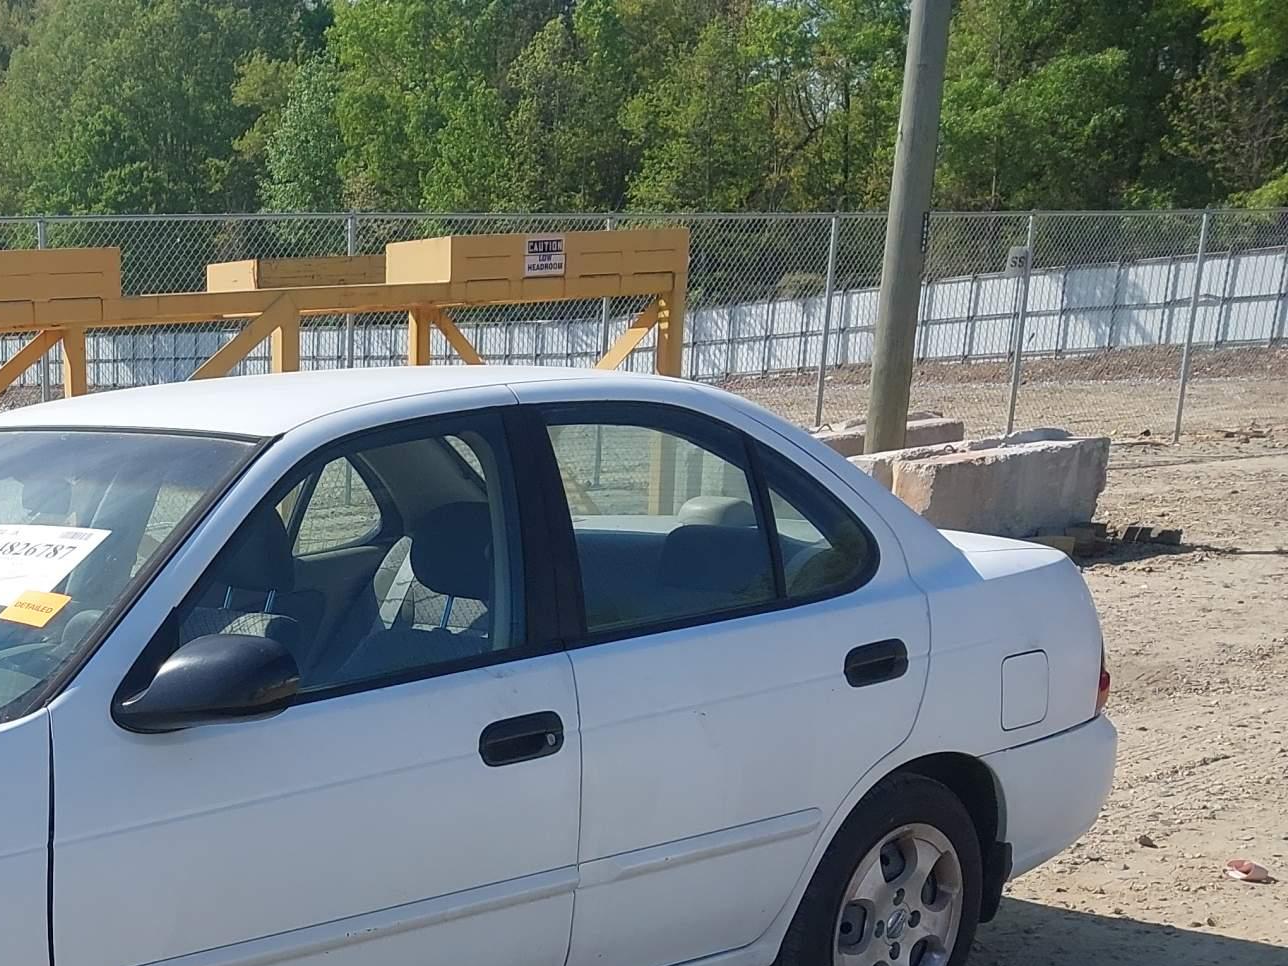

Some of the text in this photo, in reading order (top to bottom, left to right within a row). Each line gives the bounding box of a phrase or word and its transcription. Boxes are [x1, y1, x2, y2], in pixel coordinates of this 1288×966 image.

[528, 240, 563, 252] CAUTION
[538, 254, 552, 262] LOW
[527, 262, 563, 271] HEADROOM
[13, 600, 55, 614] DETAILED
